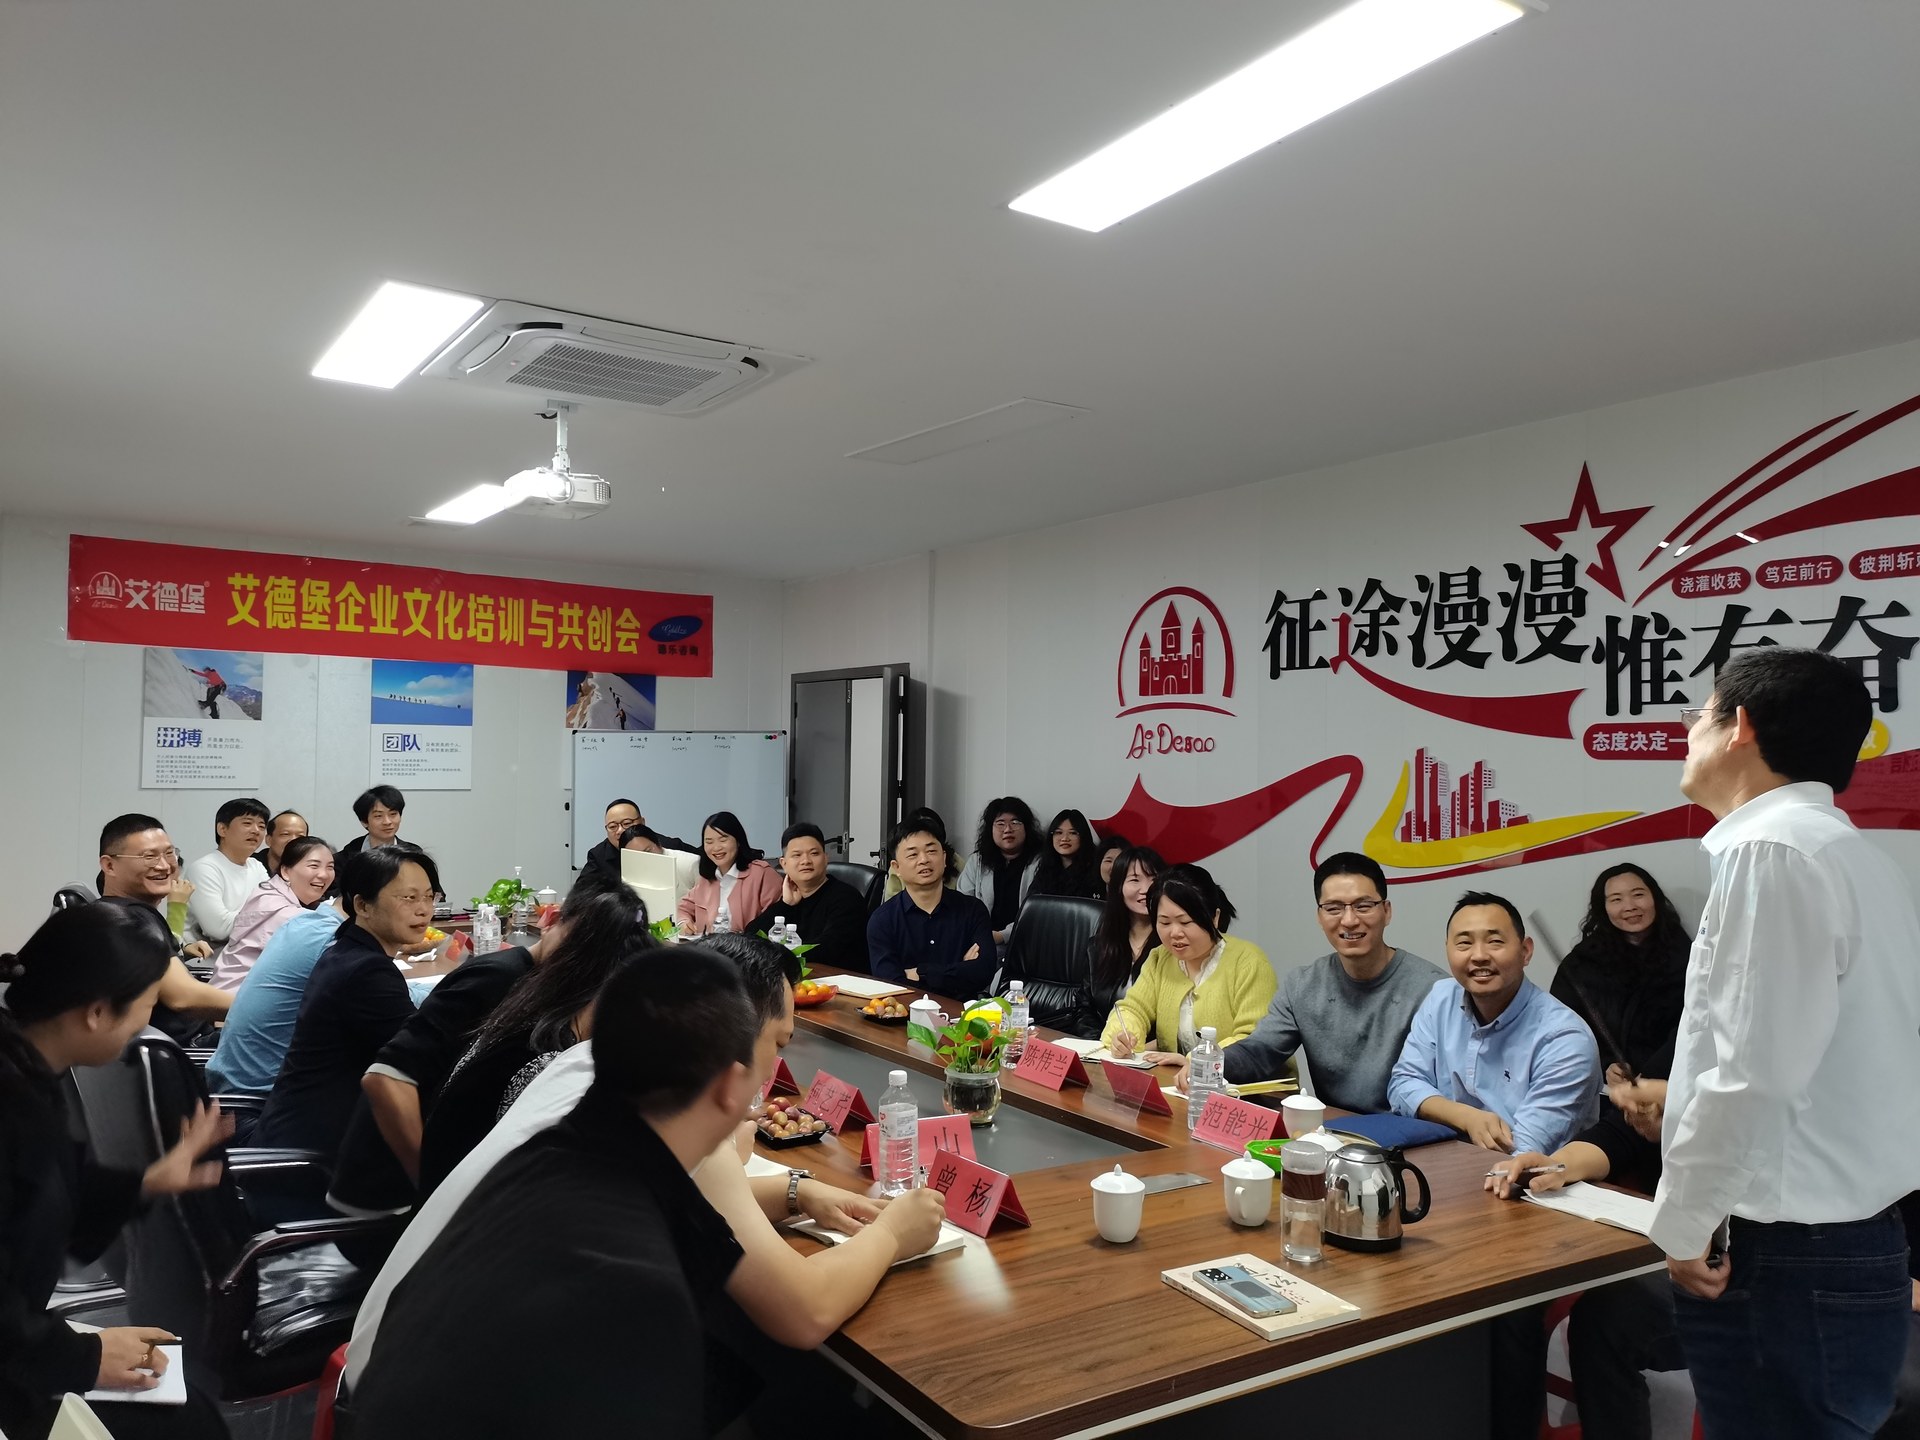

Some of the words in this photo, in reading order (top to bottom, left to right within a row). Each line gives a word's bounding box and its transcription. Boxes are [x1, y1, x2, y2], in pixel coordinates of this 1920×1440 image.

[1765, 561, 1833, 583] 笃定前行
[1859, 552, 1920, 574] 披荆斩
[124, 578, 206, 614] 艾德堡
[1680, 572, 1742, 594] 浇灌收获
[227, 572, 641, 654] 艾德堡企业文化培训与共创会
[1262, 553, 1590, 681] 征途漫漫
[156, 727, 202, 748] 拼搏
[382, 732, 421, 752] 团队
[1592, 731, 1688, 751] 态度决定一
[1020, 1044, 1068, 1078] 陈伟兰
[1202, 1101, 1268, 1140] 范能光
[934, 1164, 994, 1217] 曾杨
